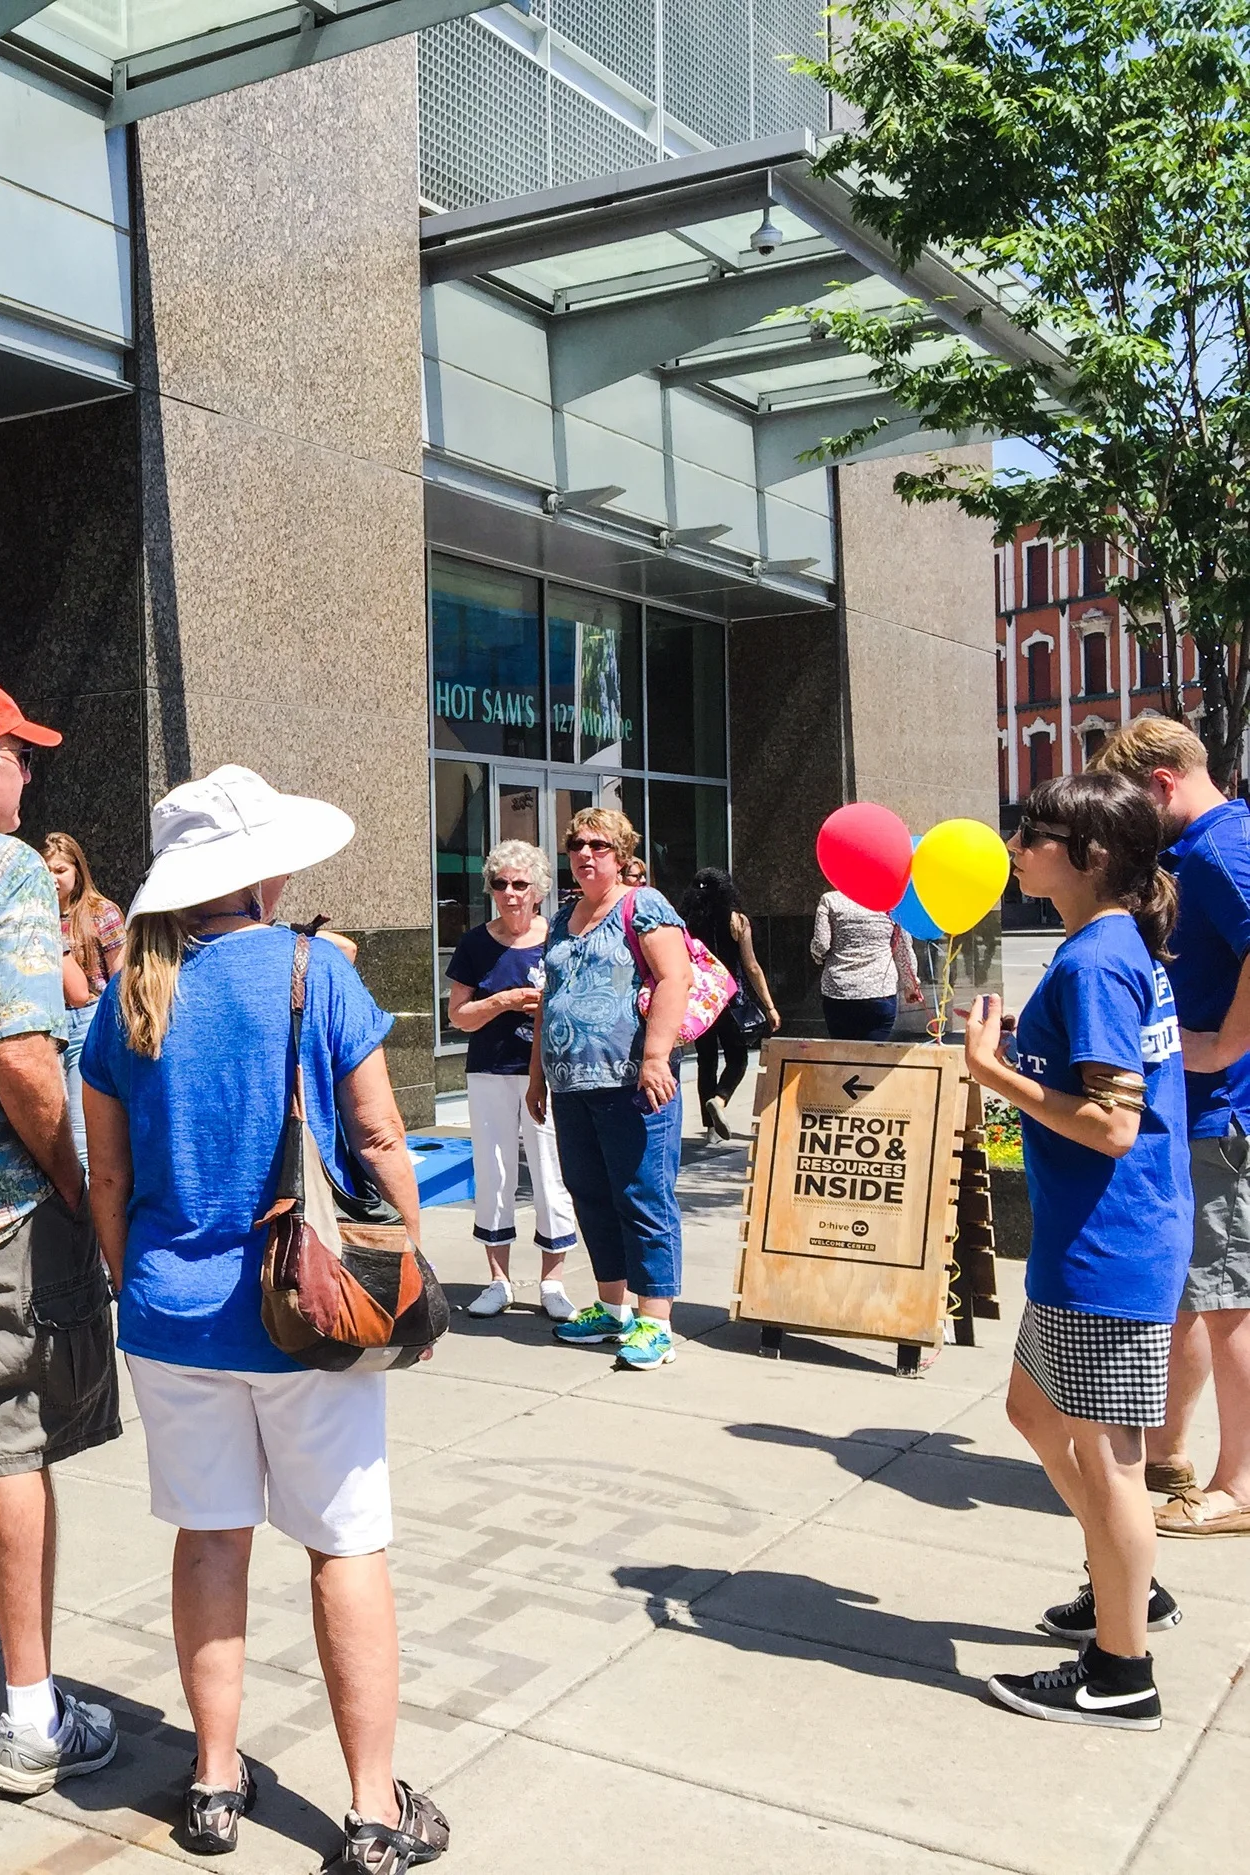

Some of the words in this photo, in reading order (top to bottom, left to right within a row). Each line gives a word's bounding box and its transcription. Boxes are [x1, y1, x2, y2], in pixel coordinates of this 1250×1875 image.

[435, 680, 477, 721] HOT
[482, 687, 536, 730] SAM'S
[553, 703, 576, 734] 127
[800, 1113, 910, 1136] DETROIT
[798, 1131, 880, 1159] INFO
[884, 1137, 907, 1161] &
[799, 1157, 904, 1178] RESOURCES
[794, 1173, 905, 1204] INSIDE
[818, 1220, 850, 1232] D:hive
[810, 1238, 846, 1249] WELCOME
[846, 1241, 875, 1251] CENTER
